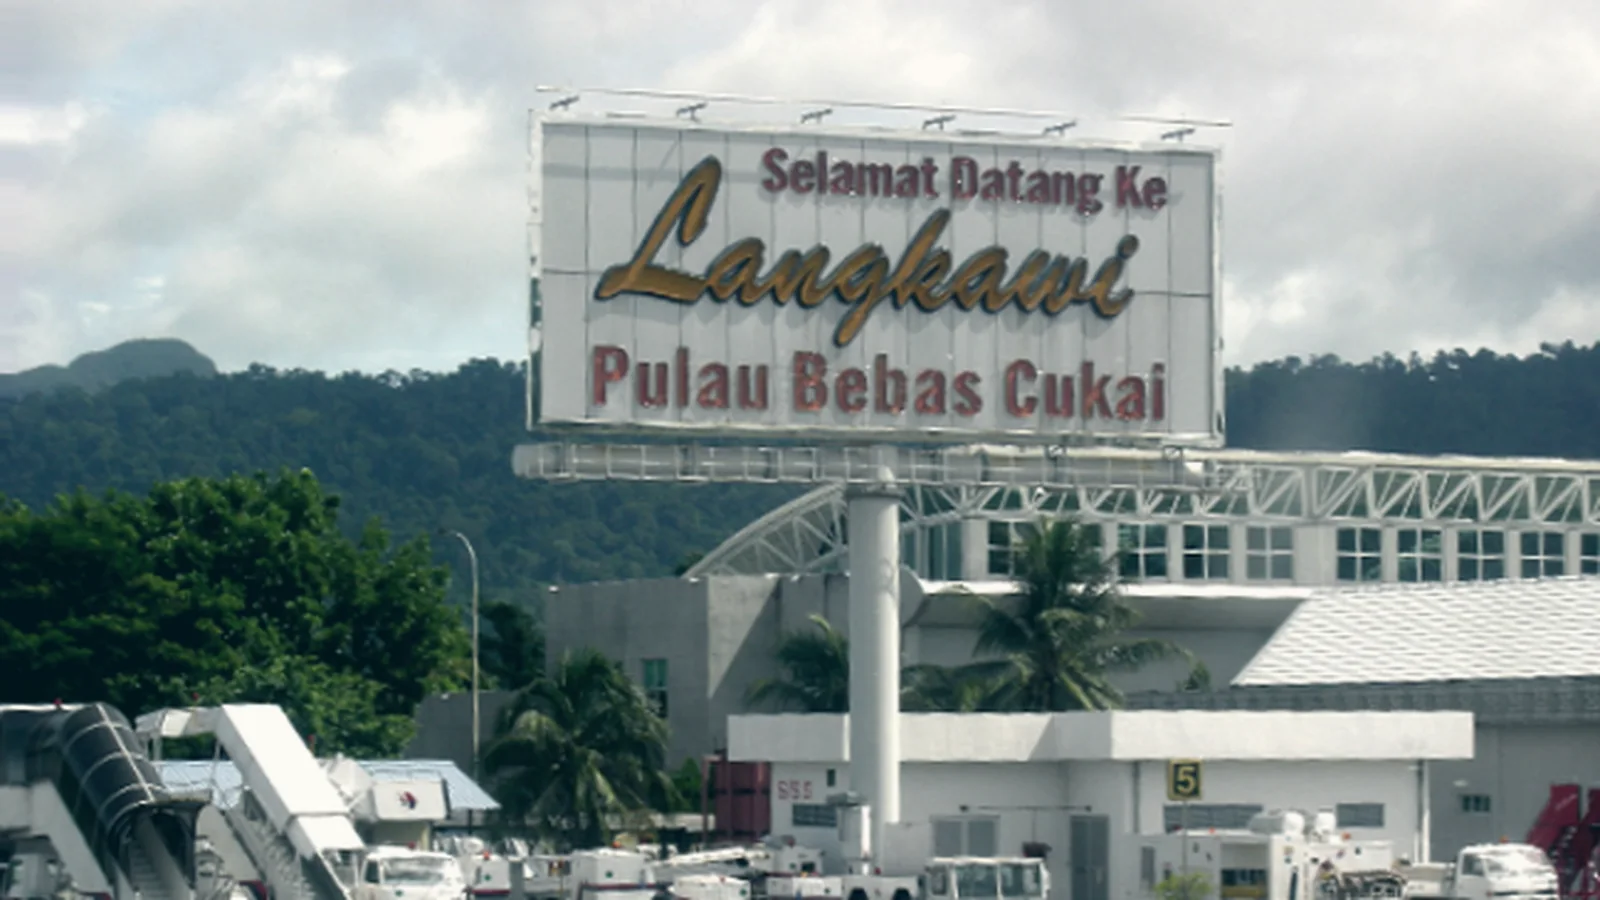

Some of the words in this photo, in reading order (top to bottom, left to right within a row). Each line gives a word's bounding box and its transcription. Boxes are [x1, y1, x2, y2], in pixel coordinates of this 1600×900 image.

[762, 147, 939, 198] Selamat
[952, 156, 1102, 215] Datang
[1115, 166, 1167, 210] Ke
[595, 155, 1139, 347] Langkawi
[593, 345, 769, 410] Pulau
[792, 351, 982, 416] Bebas
[1006, 359, 1164, 421] Cukai
[1177, 766, 1196, 793] 5
